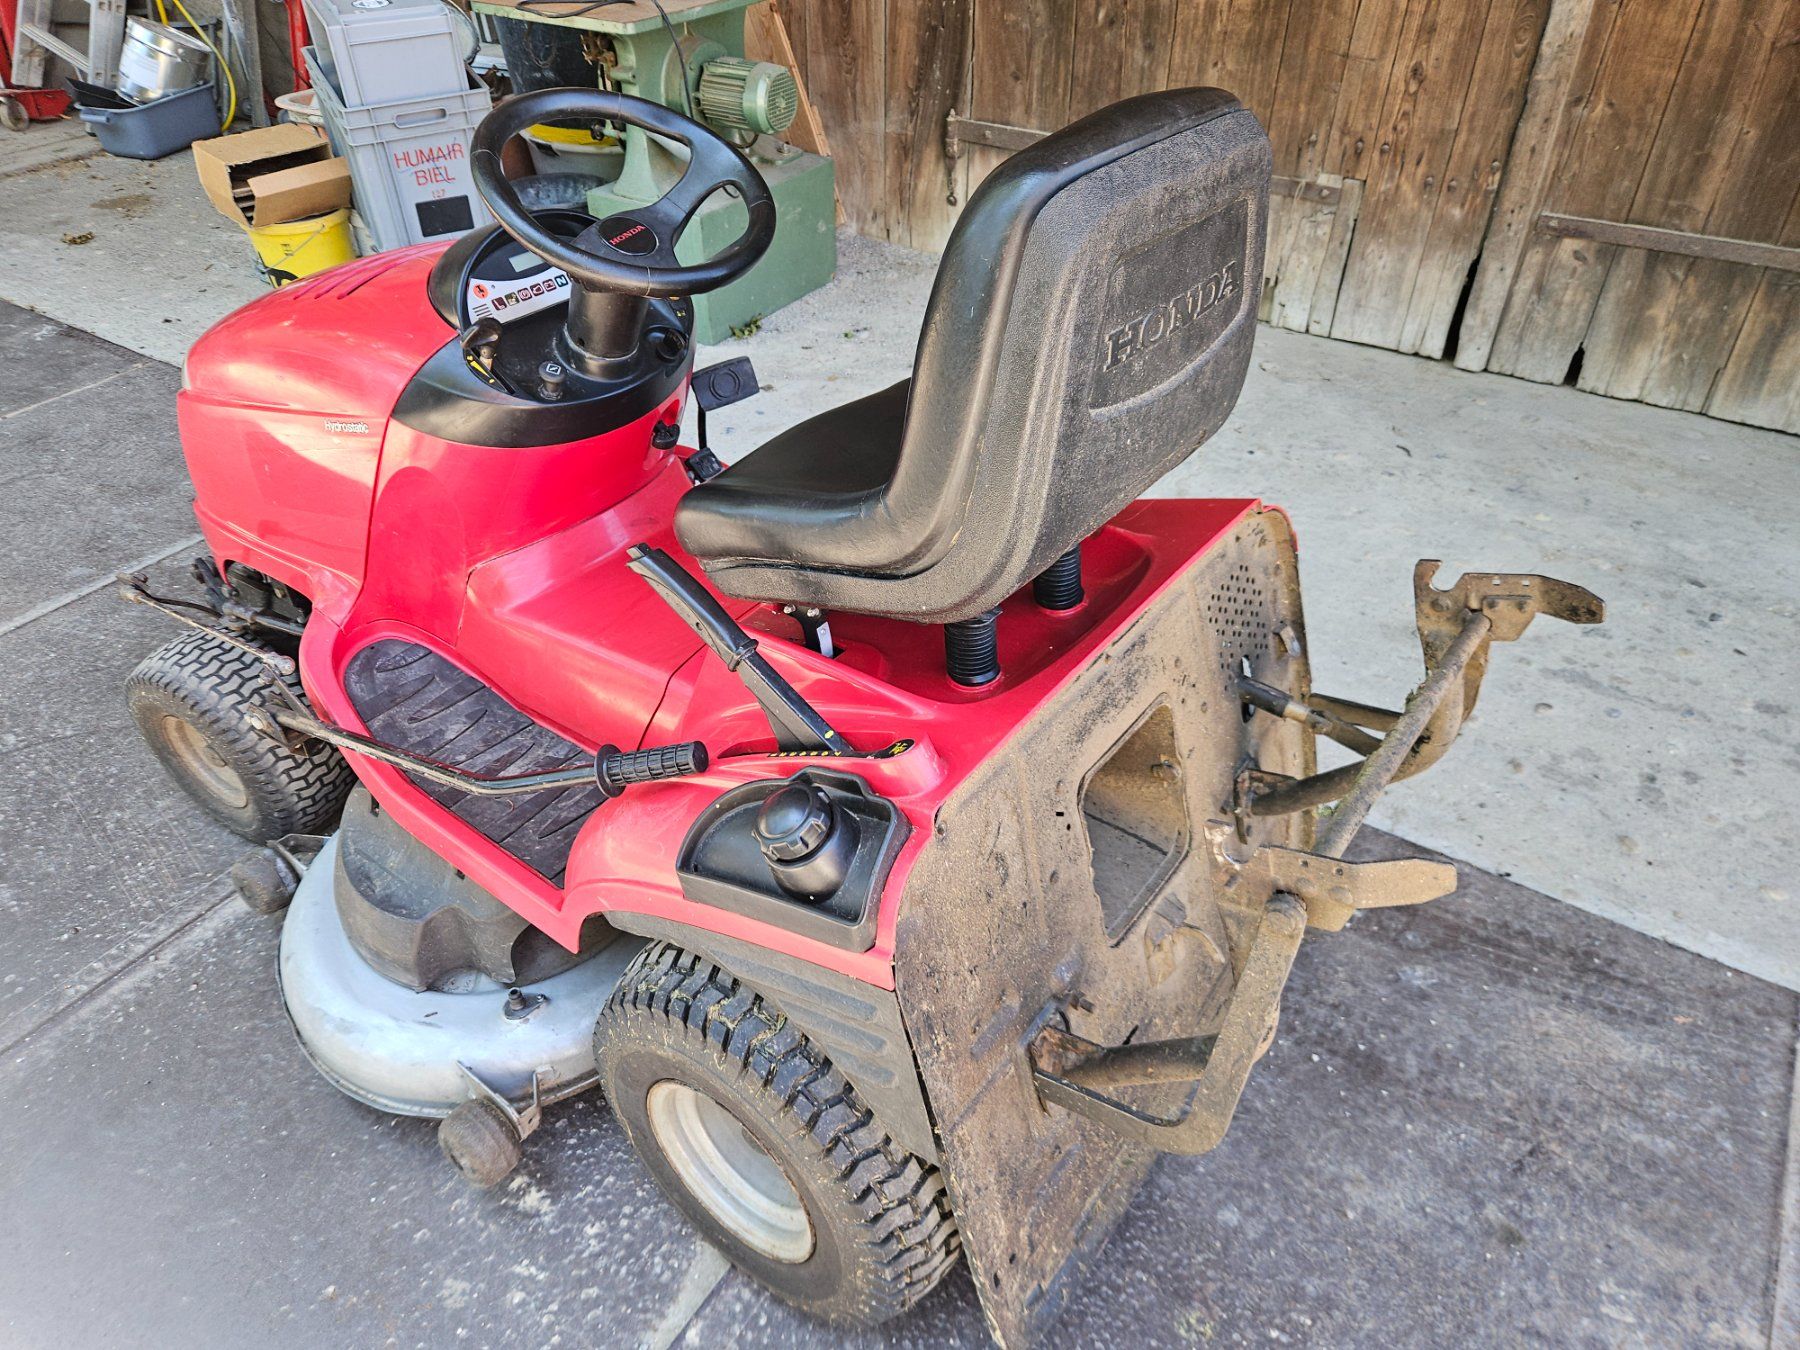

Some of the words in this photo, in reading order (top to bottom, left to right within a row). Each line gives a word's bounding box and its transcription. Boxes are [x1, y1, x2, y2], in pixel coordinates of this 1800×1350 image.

[394, 143, 464, 169] HUMAIR
[414, 166, 456, 187] BIEL
[610, 225, 646, 245] HONDA
[1103, 260, 1240, 372] HONDA
[324, 420, 369, 434] Hydrostatic
